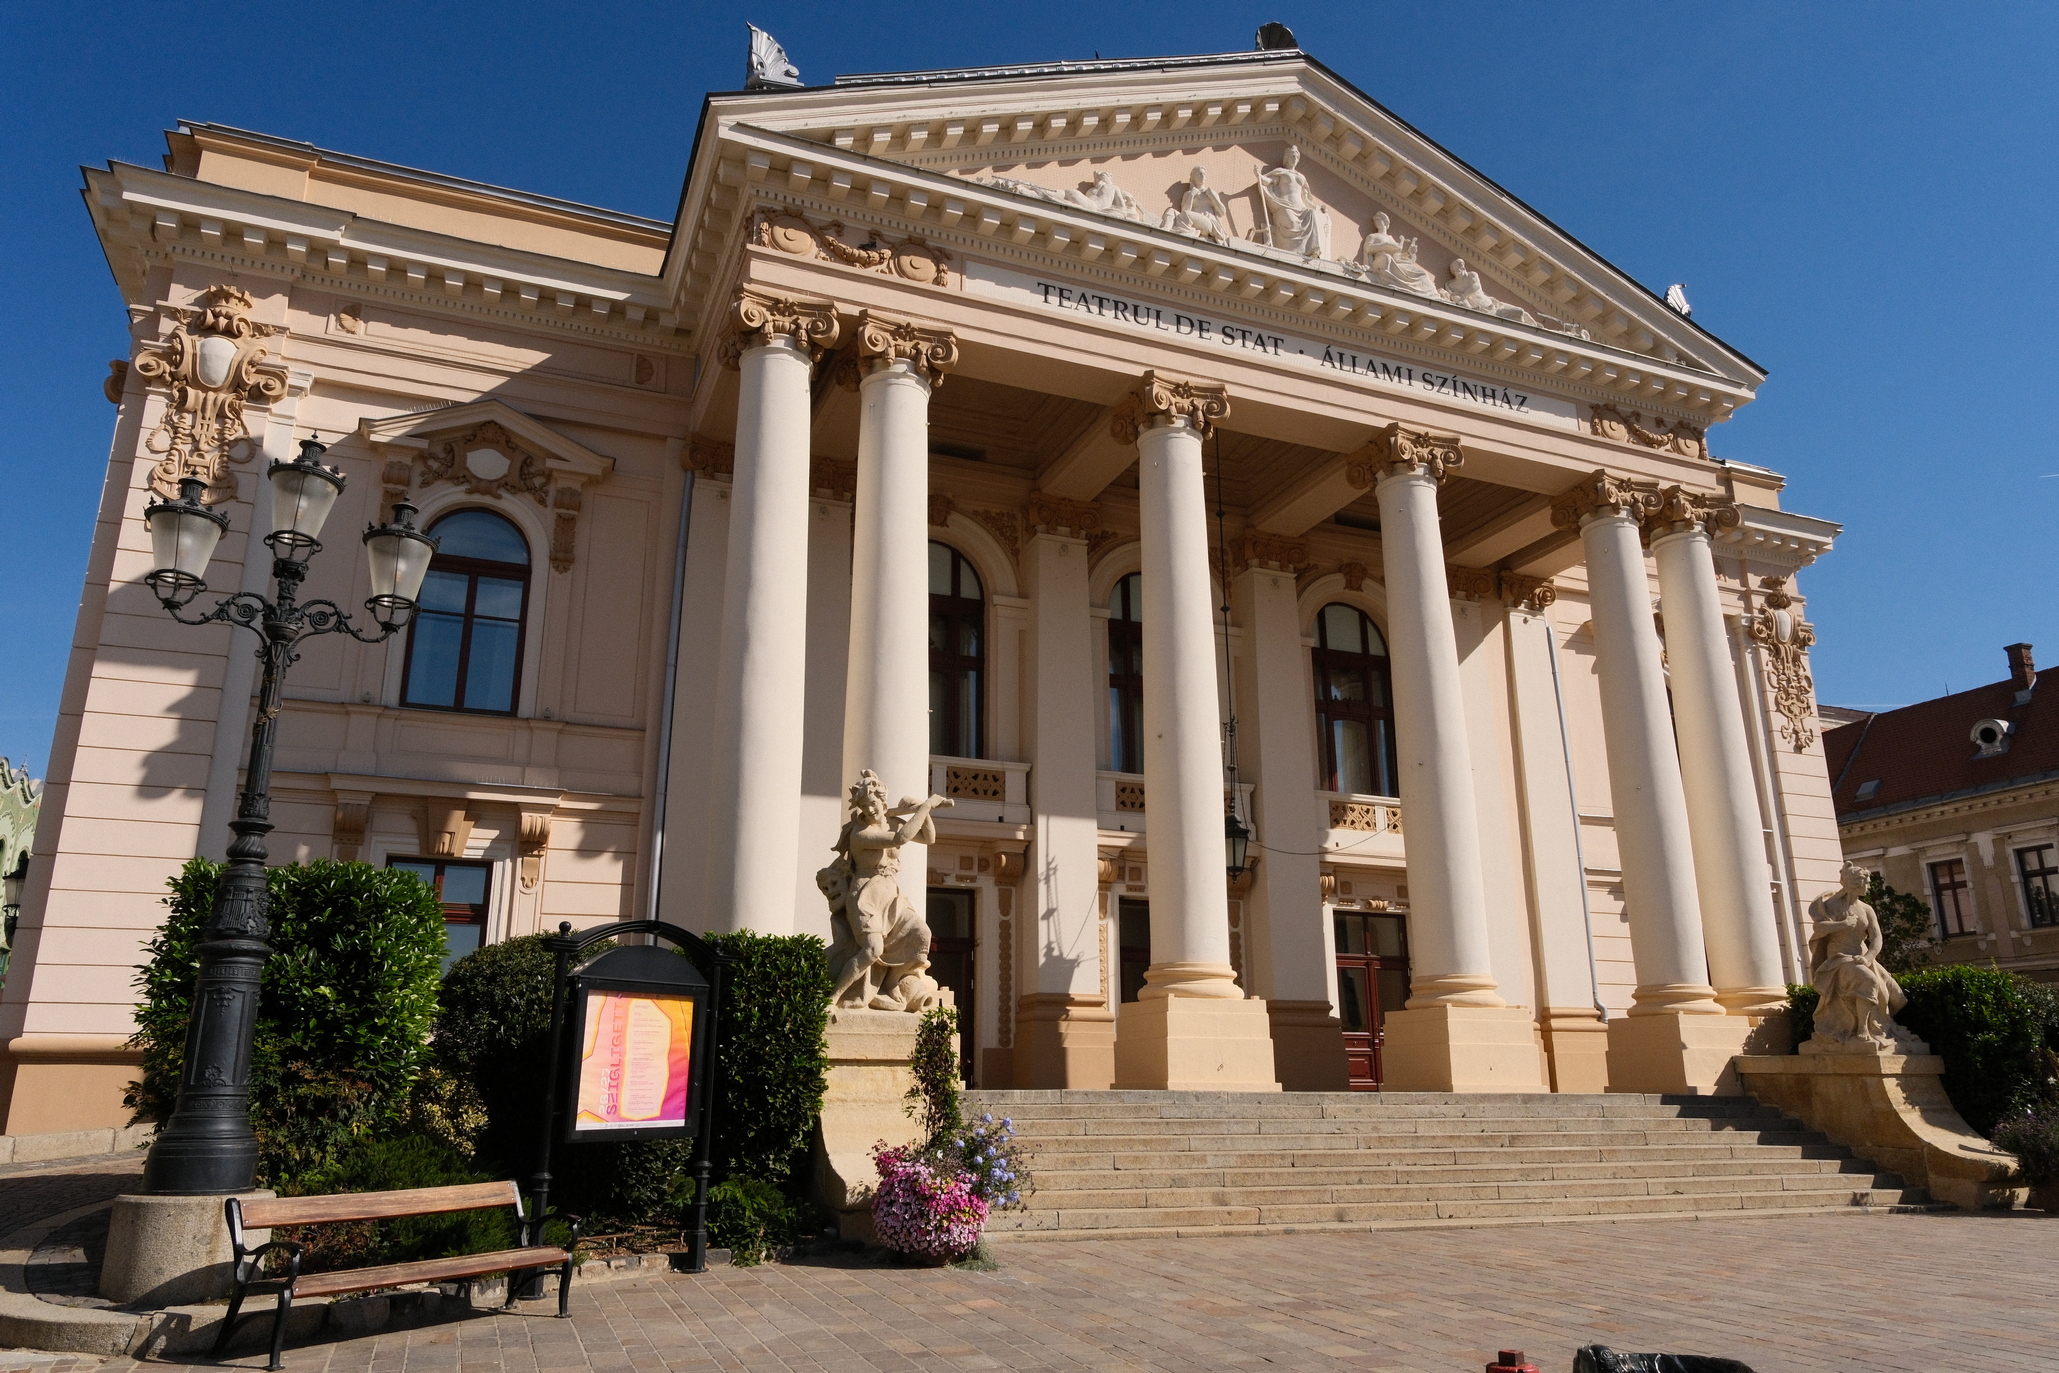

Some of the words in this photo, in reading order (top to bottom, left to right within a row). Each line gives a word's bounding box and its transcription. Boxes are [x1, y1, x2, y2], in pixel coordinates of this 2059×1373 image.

[1038, 282, 1169, 330] TEATRUL
[1175, 314, 1212, 340] DE
[1221, 326, 1284, 356] STAT
[1320, 345, 1413, 387] ÁLLAMI
[1421, 372, 1529, 414] SZÍNHÁZ
[607, 1002, 623, 1116] SZIGLIGETI
